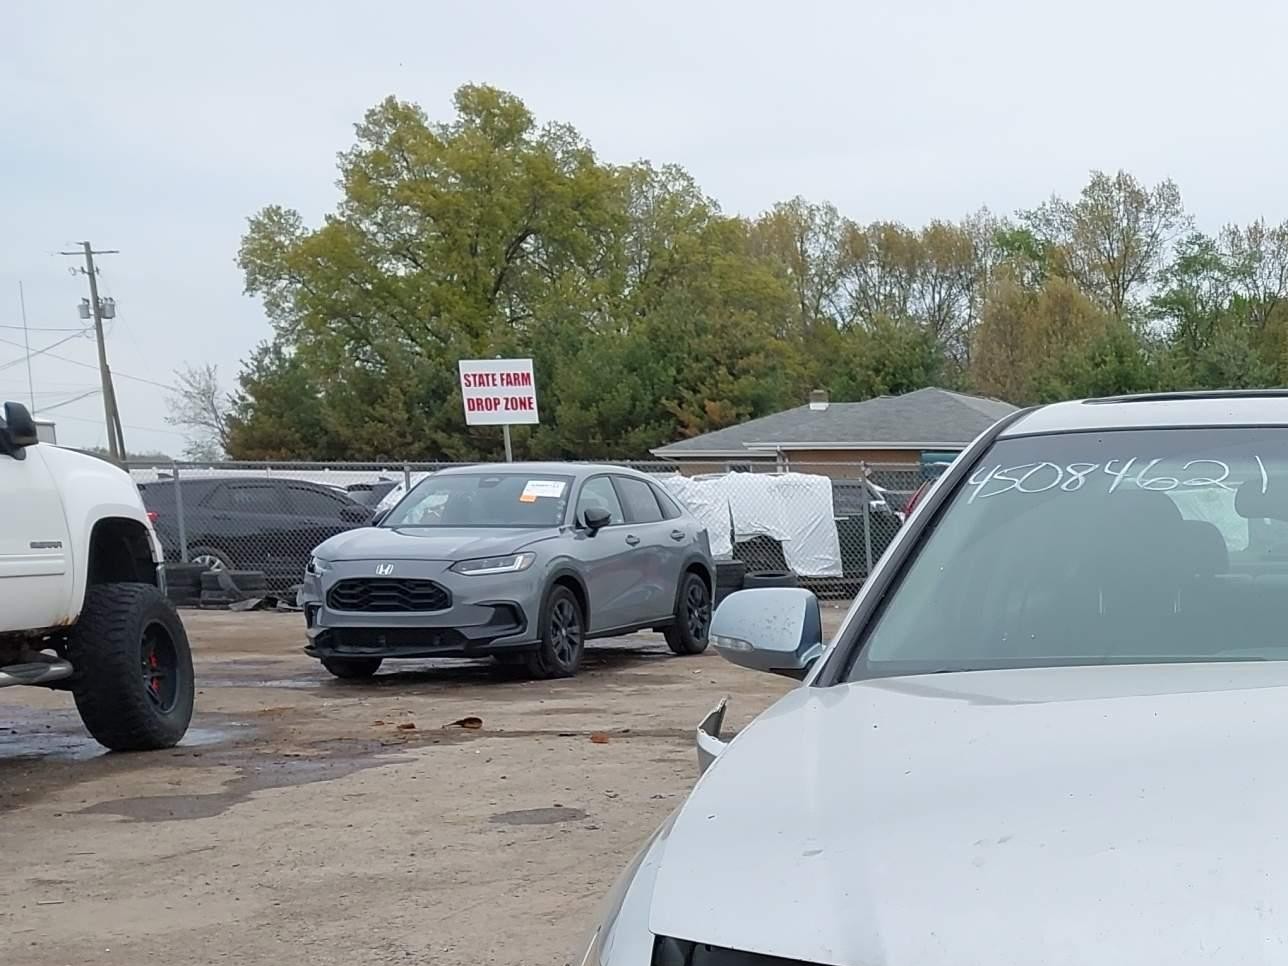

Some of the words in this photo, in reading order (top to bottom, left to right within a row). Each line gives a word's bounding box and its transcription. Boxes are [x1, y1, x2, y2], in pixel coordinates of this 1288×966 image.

[463, 372, 497, 387] STATE
[500, 372, 532, 387] FARM
[467, 397, 501, 412] DROP
[503, 396, 534, 411] ZONE
[966, 455, 1270, 505] 45084621
